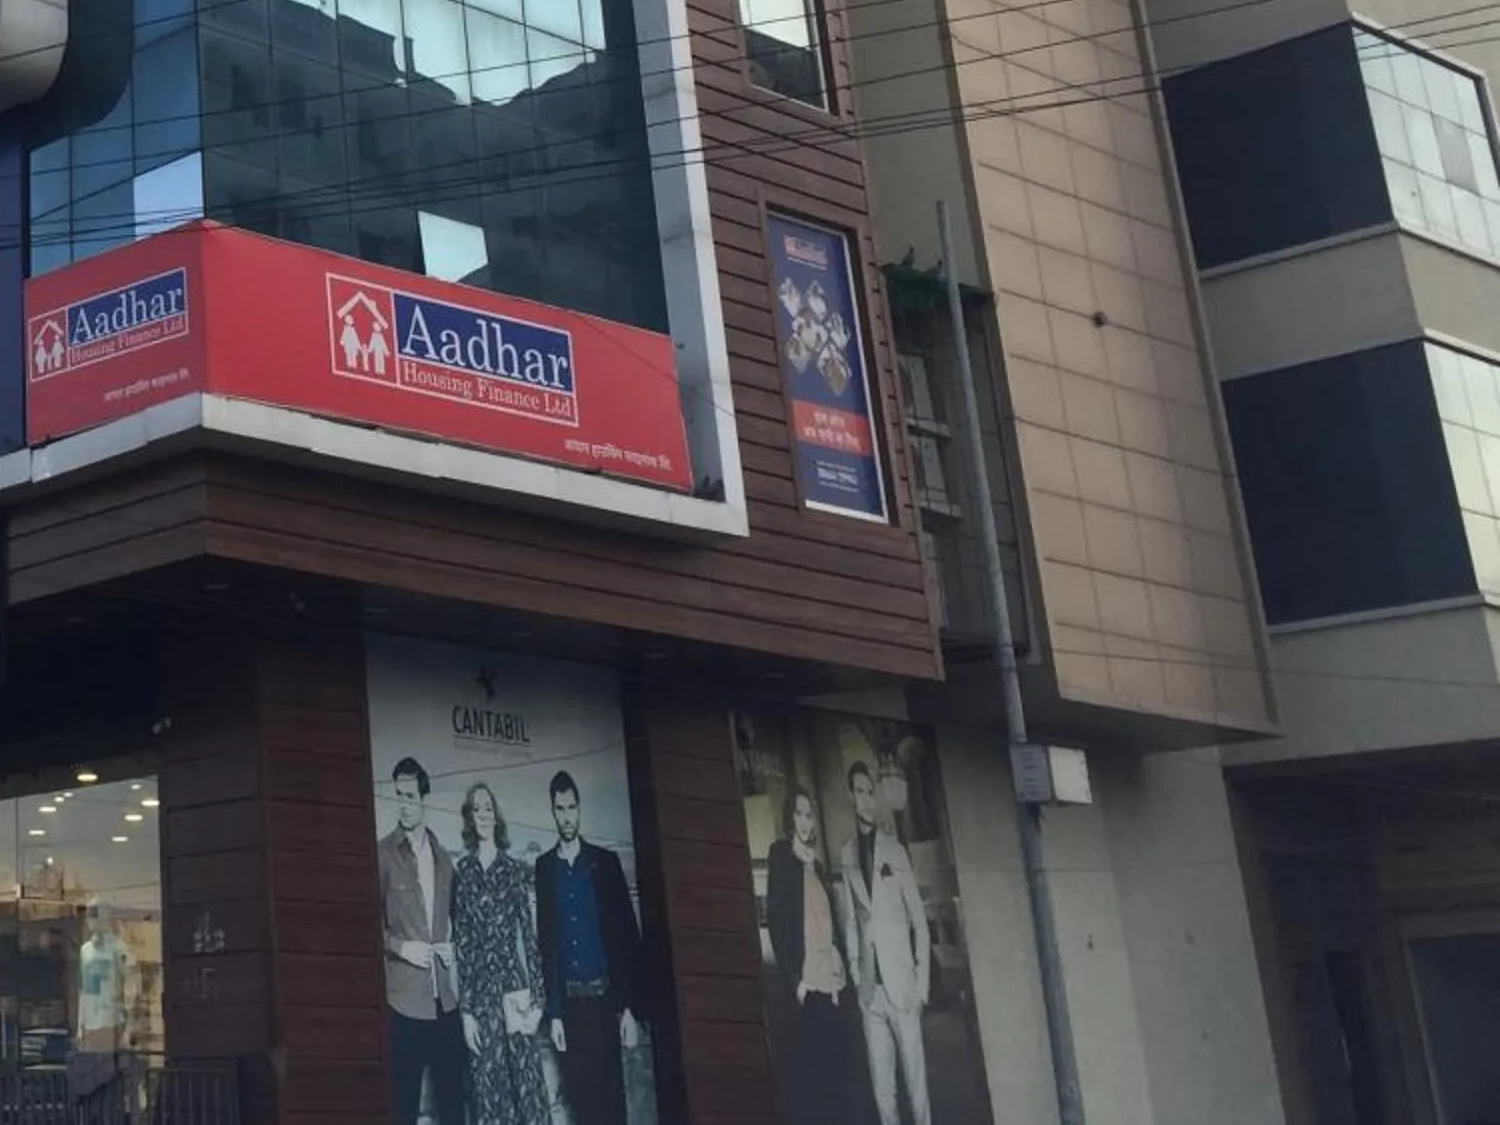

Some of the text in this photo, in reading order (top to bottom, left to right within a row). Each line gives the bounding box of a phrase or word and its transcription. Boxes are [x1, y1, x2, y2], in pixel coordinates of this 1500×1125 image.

[73, 288, 183, 344] Aadhar
[164, 315, 184, 335] Ltd
[401, 303, 568, 389] Aadhar
[403, 360, 571, 416] Housing Finance Ltd
[451, 704, 531, 742] CANTABIL
